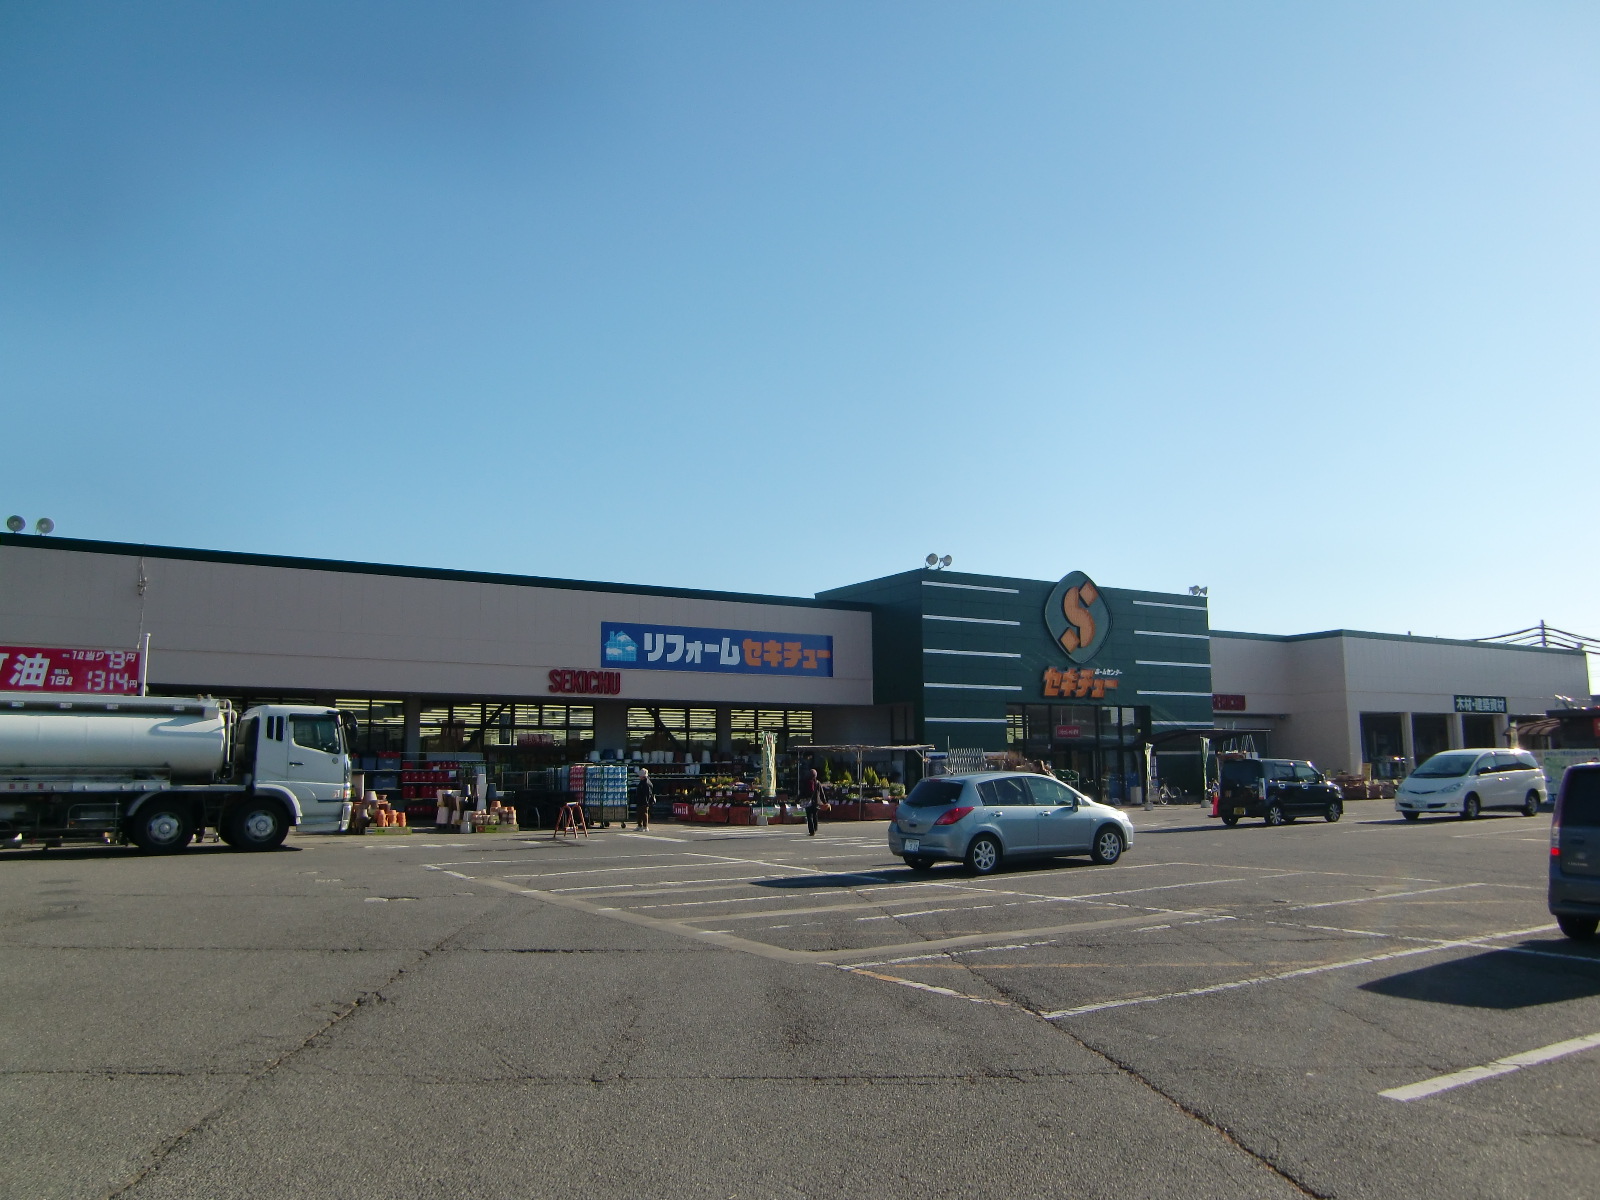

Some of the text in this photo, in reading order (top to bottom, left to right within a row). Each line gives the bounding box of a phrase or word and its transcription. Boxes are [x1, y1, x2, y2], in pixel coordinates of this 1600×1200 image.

[548, 669, 621, 695] SEKICHU
[1042, 666, 1119, 699] セキチュー
